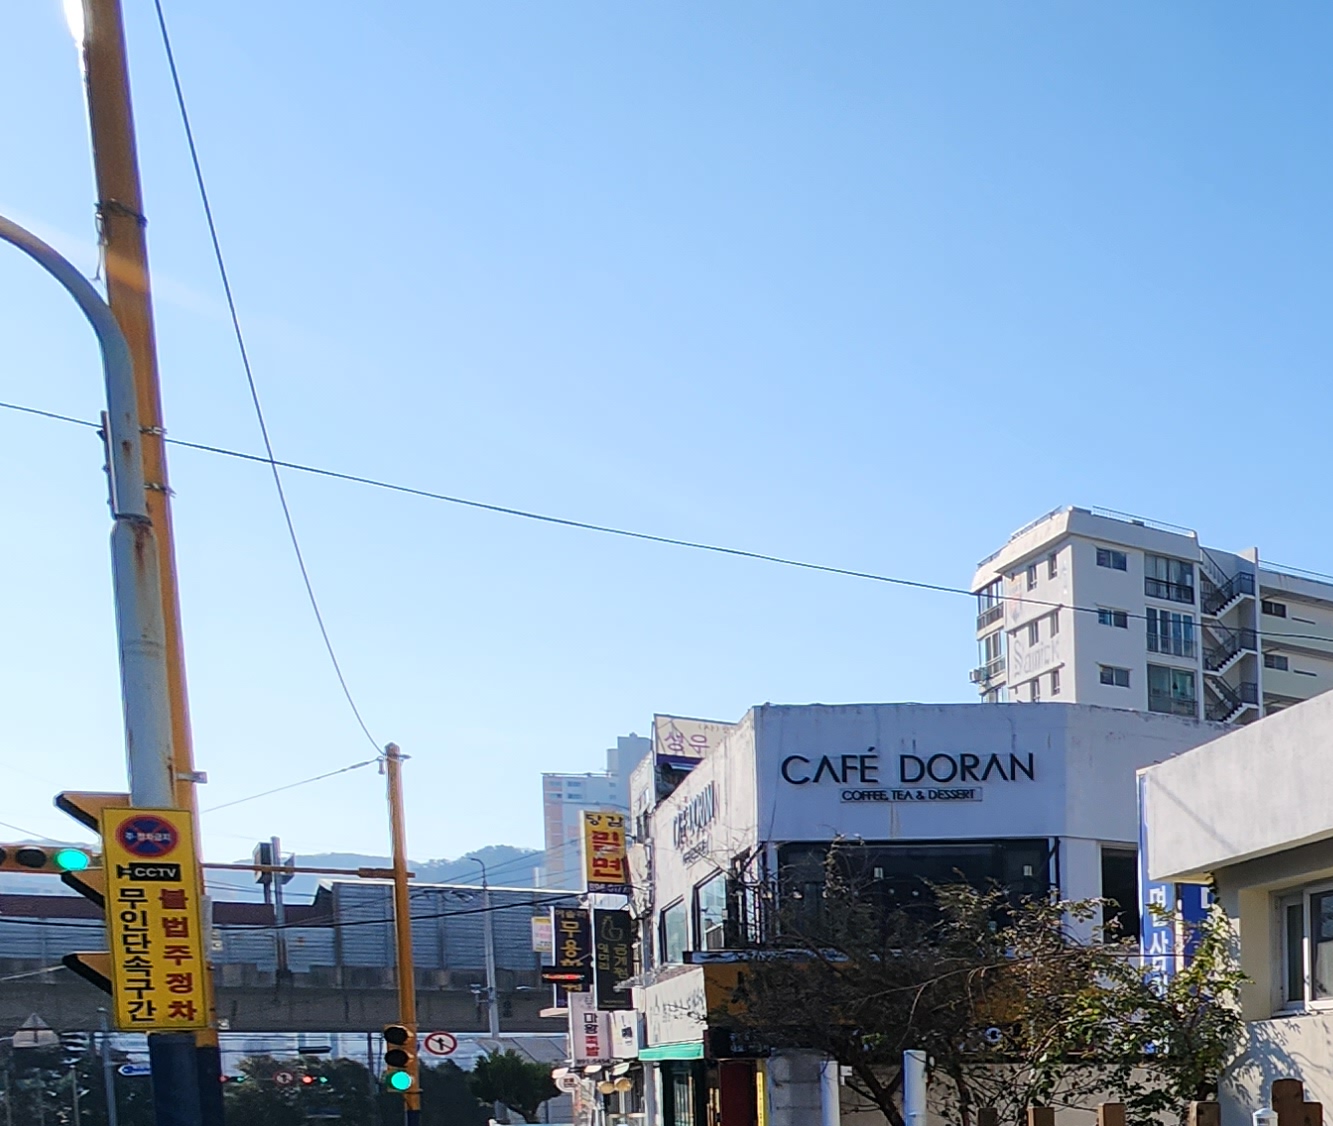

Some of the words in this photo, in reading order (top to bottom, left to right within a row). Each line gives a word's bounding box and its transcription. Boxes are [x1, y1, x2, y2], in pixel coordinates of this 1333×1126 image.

[781, 746, 879, 785] CAFÉ
[900, 752, 1035, 783] DORAN
[891, 790, 914, 801] TEA
[915, 789, 926, 800] &
[928, 789, 976, 800] DESSERT
[134, 867, 177, 878] CCTV
[117, 888, 157, 1023] 무인단속구간
[158, 888, 197, 1022] 불법주정차
